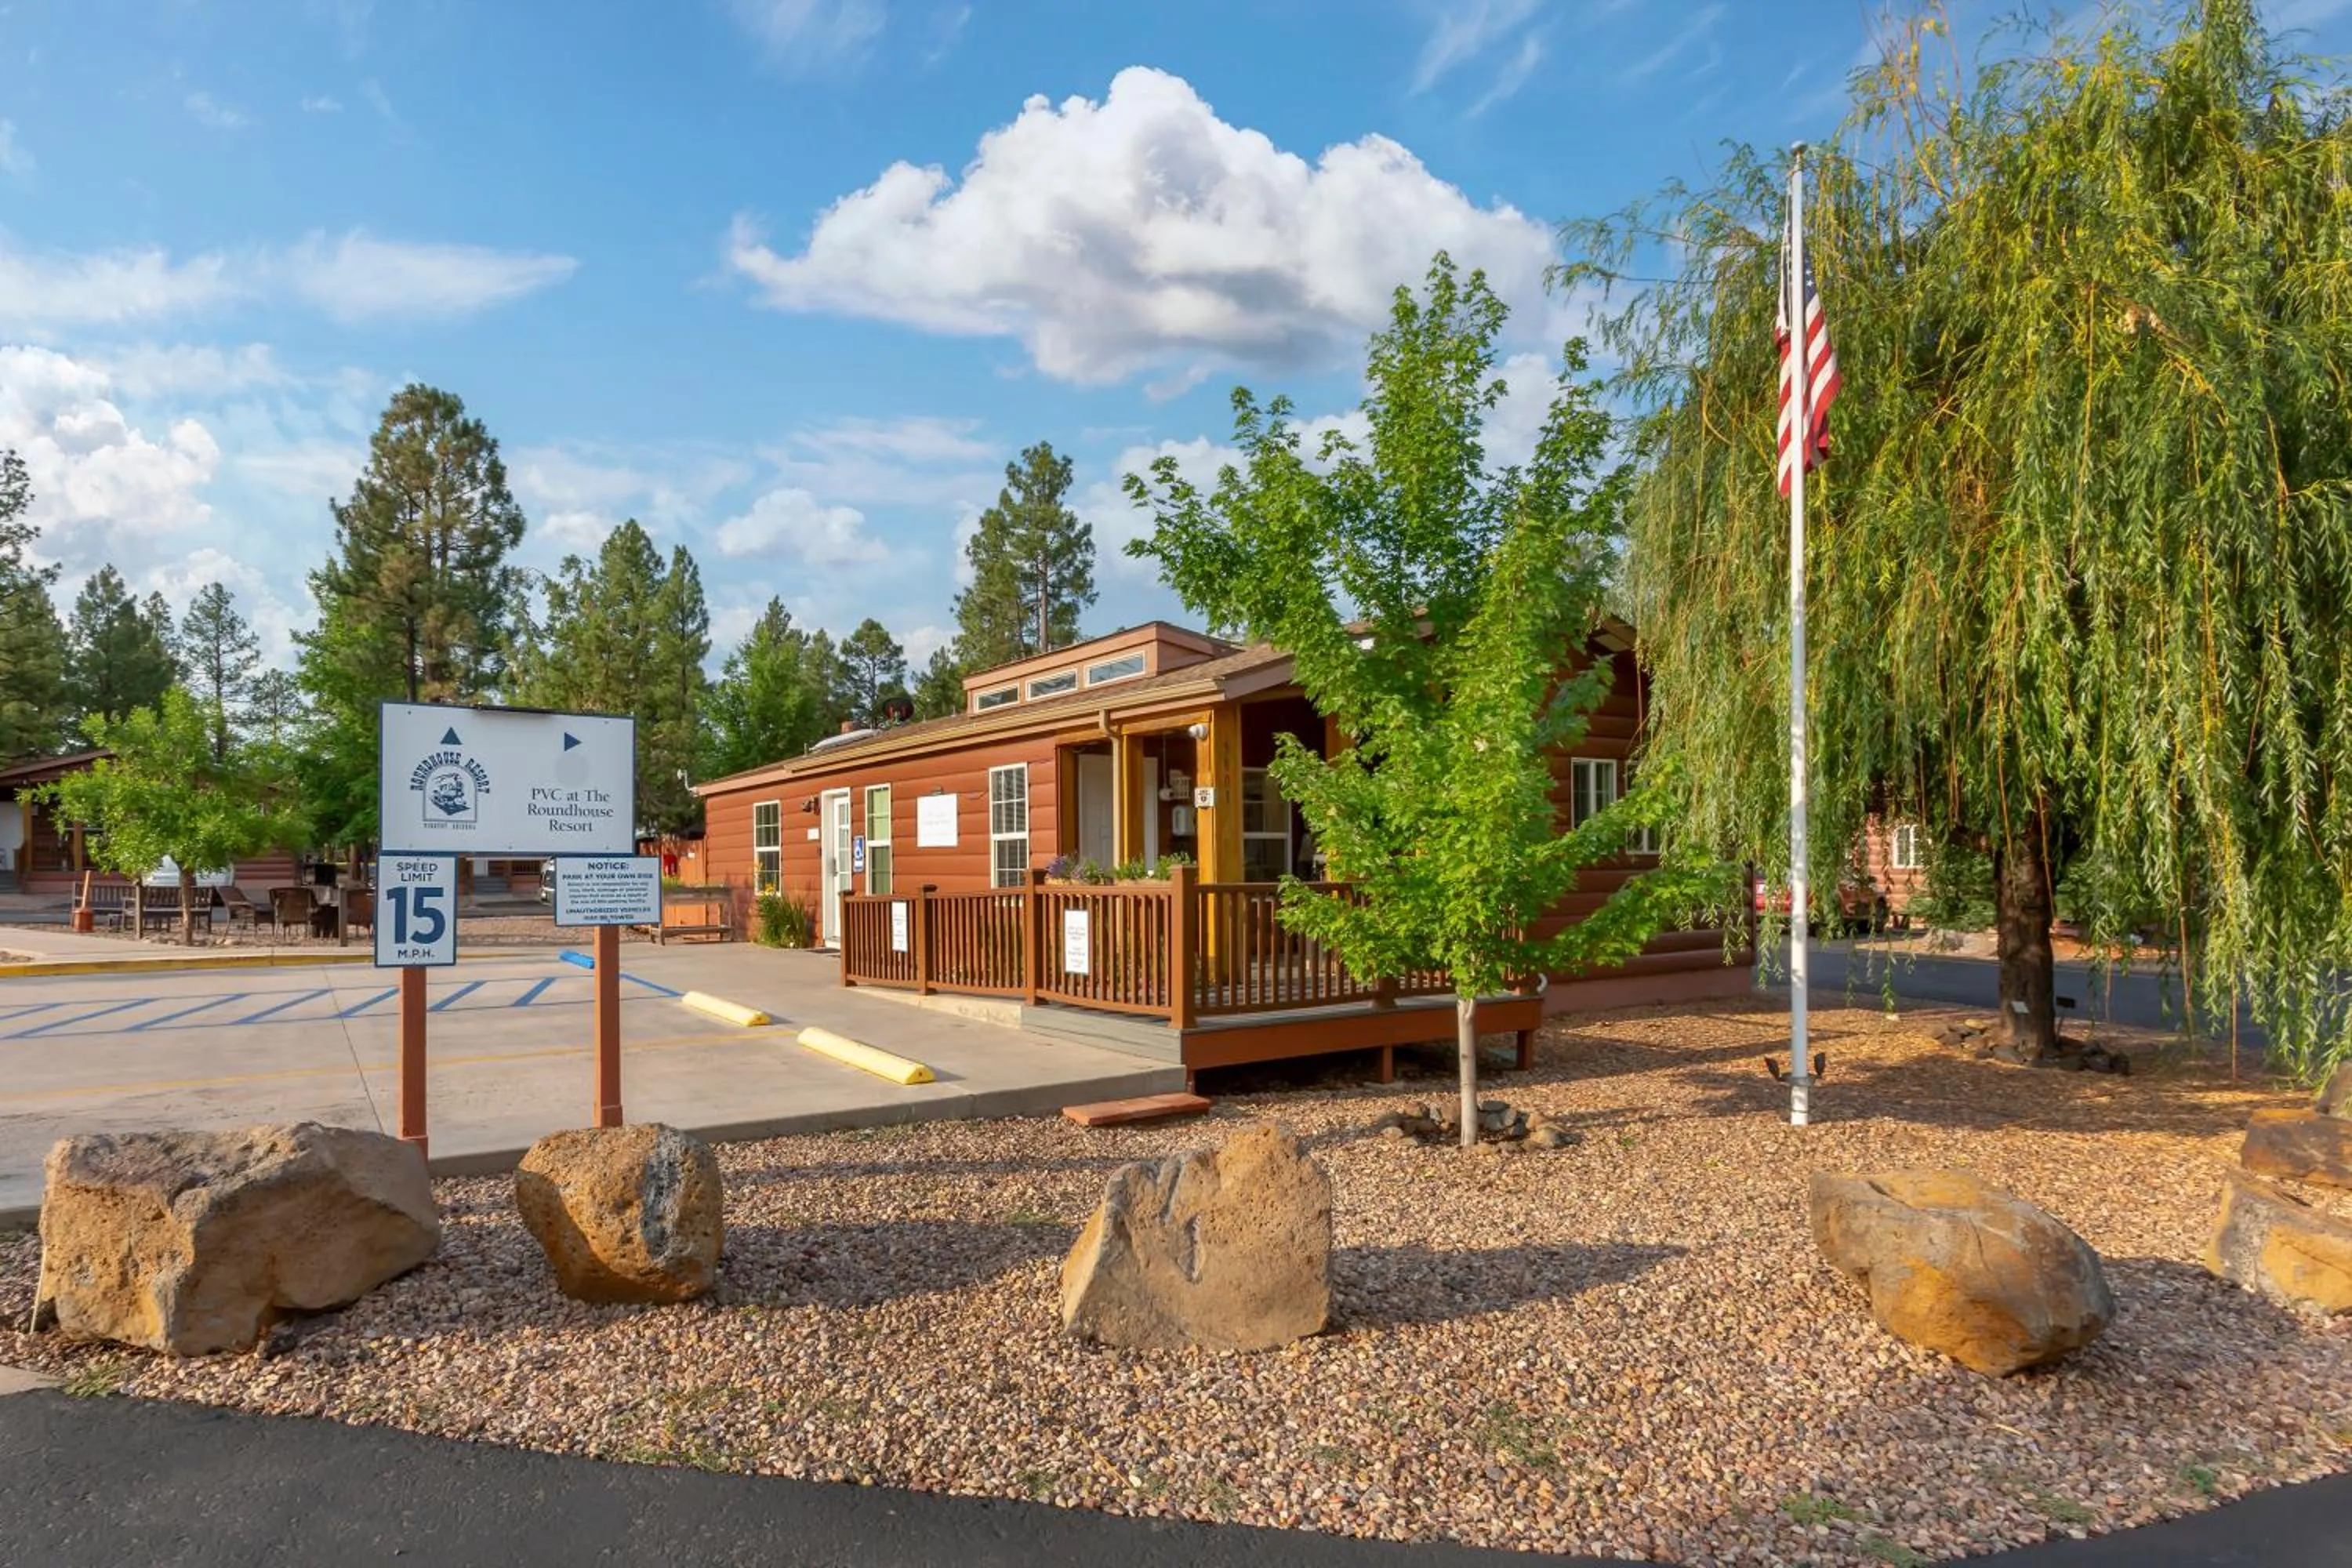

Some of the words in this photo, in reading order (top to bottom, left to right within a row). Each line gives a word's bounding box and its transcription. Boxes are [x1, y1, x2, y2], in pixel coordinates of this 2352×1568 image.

[410, 752, 462, 790] ROUNDHOUSE
[465, 757, 490, 793] RESORT
[532, 788, 562, 800] PVC
[567, 791, 579, 801] at
[584, 789, 611, 802] The
[528, 802, 615, 817] Roundhouse
[549, 818, 593, 832] Resort
[396, 862, 438, 872] SPEED
[587, 862, 630, 870] NOTICE:
[401, 873, 434, 882] LIMIT
[387, 886, 446, 944] 15
[397, 949, 436, 958] M.P.H.
